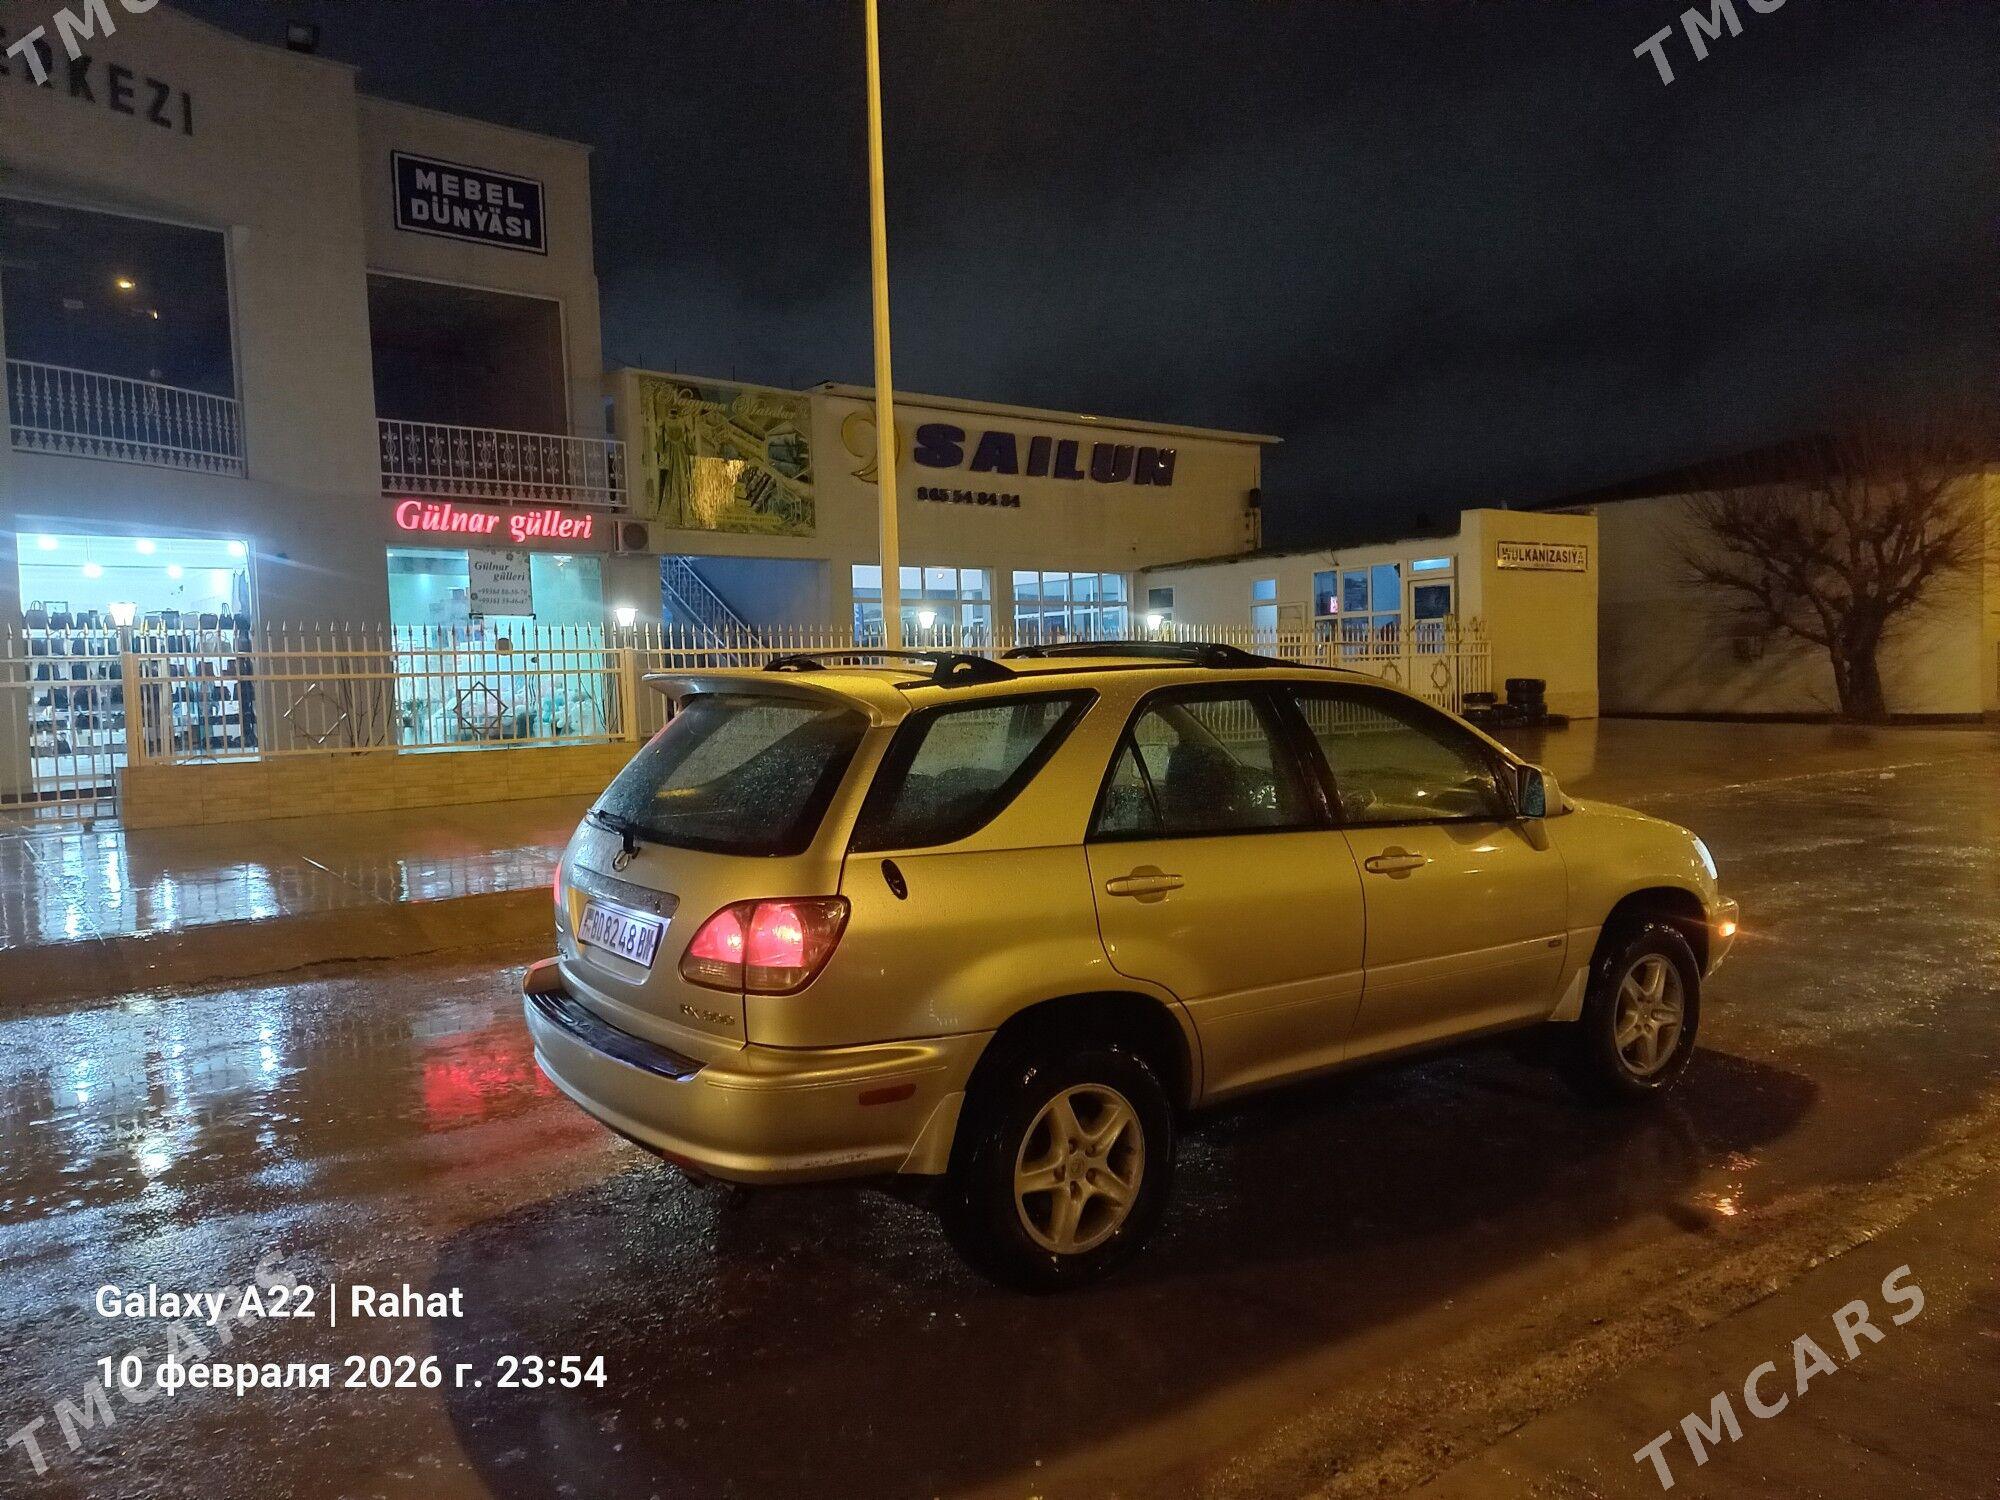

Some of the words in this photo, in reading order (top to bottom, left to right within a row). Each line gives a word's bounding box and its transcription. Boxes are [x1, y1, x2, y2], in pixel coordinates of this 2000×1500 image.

[415, 168, 524, 209] MEBEL
[914, 423, 1176, 486] SAILUN
[396, 500, 499, 534] Gülnar
[510, 510, 592, 543] gülleri
[474, 561, 509, 571] Gülnar
[493, 572, 525, 582] gülleri
